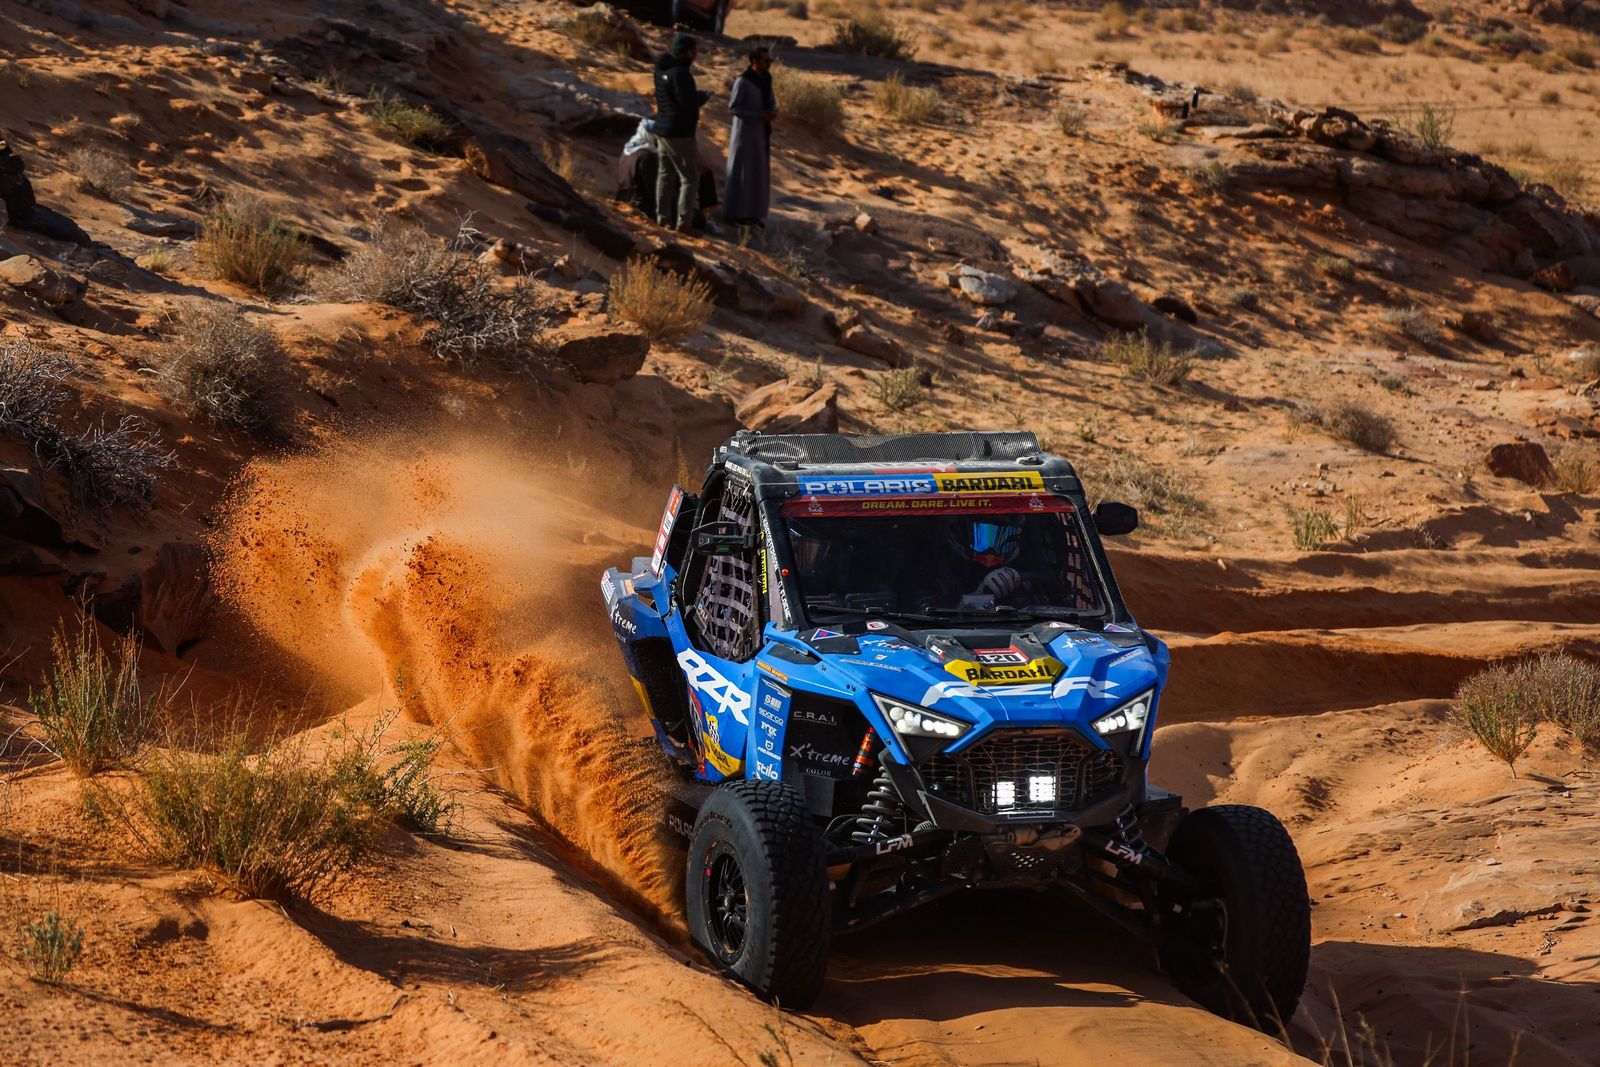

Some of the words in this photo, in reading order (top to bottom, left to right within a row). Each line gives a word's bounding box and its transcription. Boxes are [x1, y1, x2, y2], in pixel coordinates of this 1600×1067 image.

[804, 478, 933, 495] POLARIS
[941, 476, 1040, 492] BARDAHL
[861, 501, 909, 509] DREAM.
[911, 500, 947, 508] DARE.
[949, 499, 977, 507] LIVE
[978, 499, 992, 507] IT.
[965, 664, 1056, 682] BARDAHL
[676, 647, 751, 726] RZR
